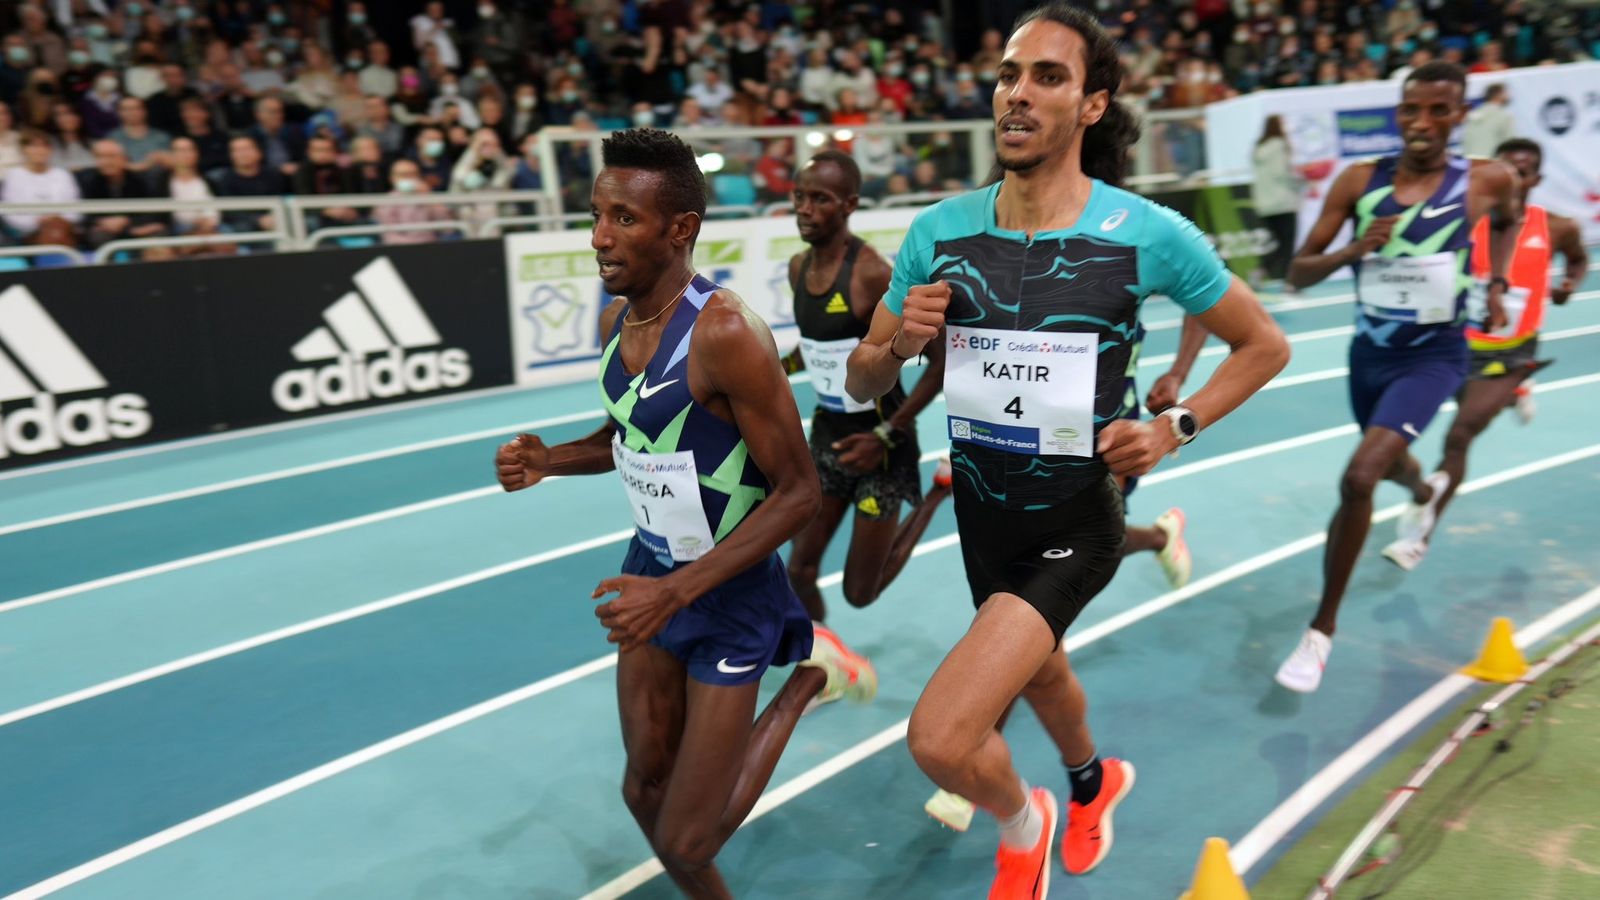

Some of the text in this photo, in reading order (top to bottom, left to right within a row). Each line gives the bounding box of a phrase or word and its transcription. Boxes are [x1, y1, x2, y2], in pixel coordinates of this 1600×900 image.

[272, 345, 471, 411] adidas
[983, 361, 1050, 383] KATIR
[823, 377, 832, 391] 7
[1004, 396, 1024, 420] 4
[971, 431, 1038, 450] Hauts-de-France
[641, 504, 651, 526] 1
